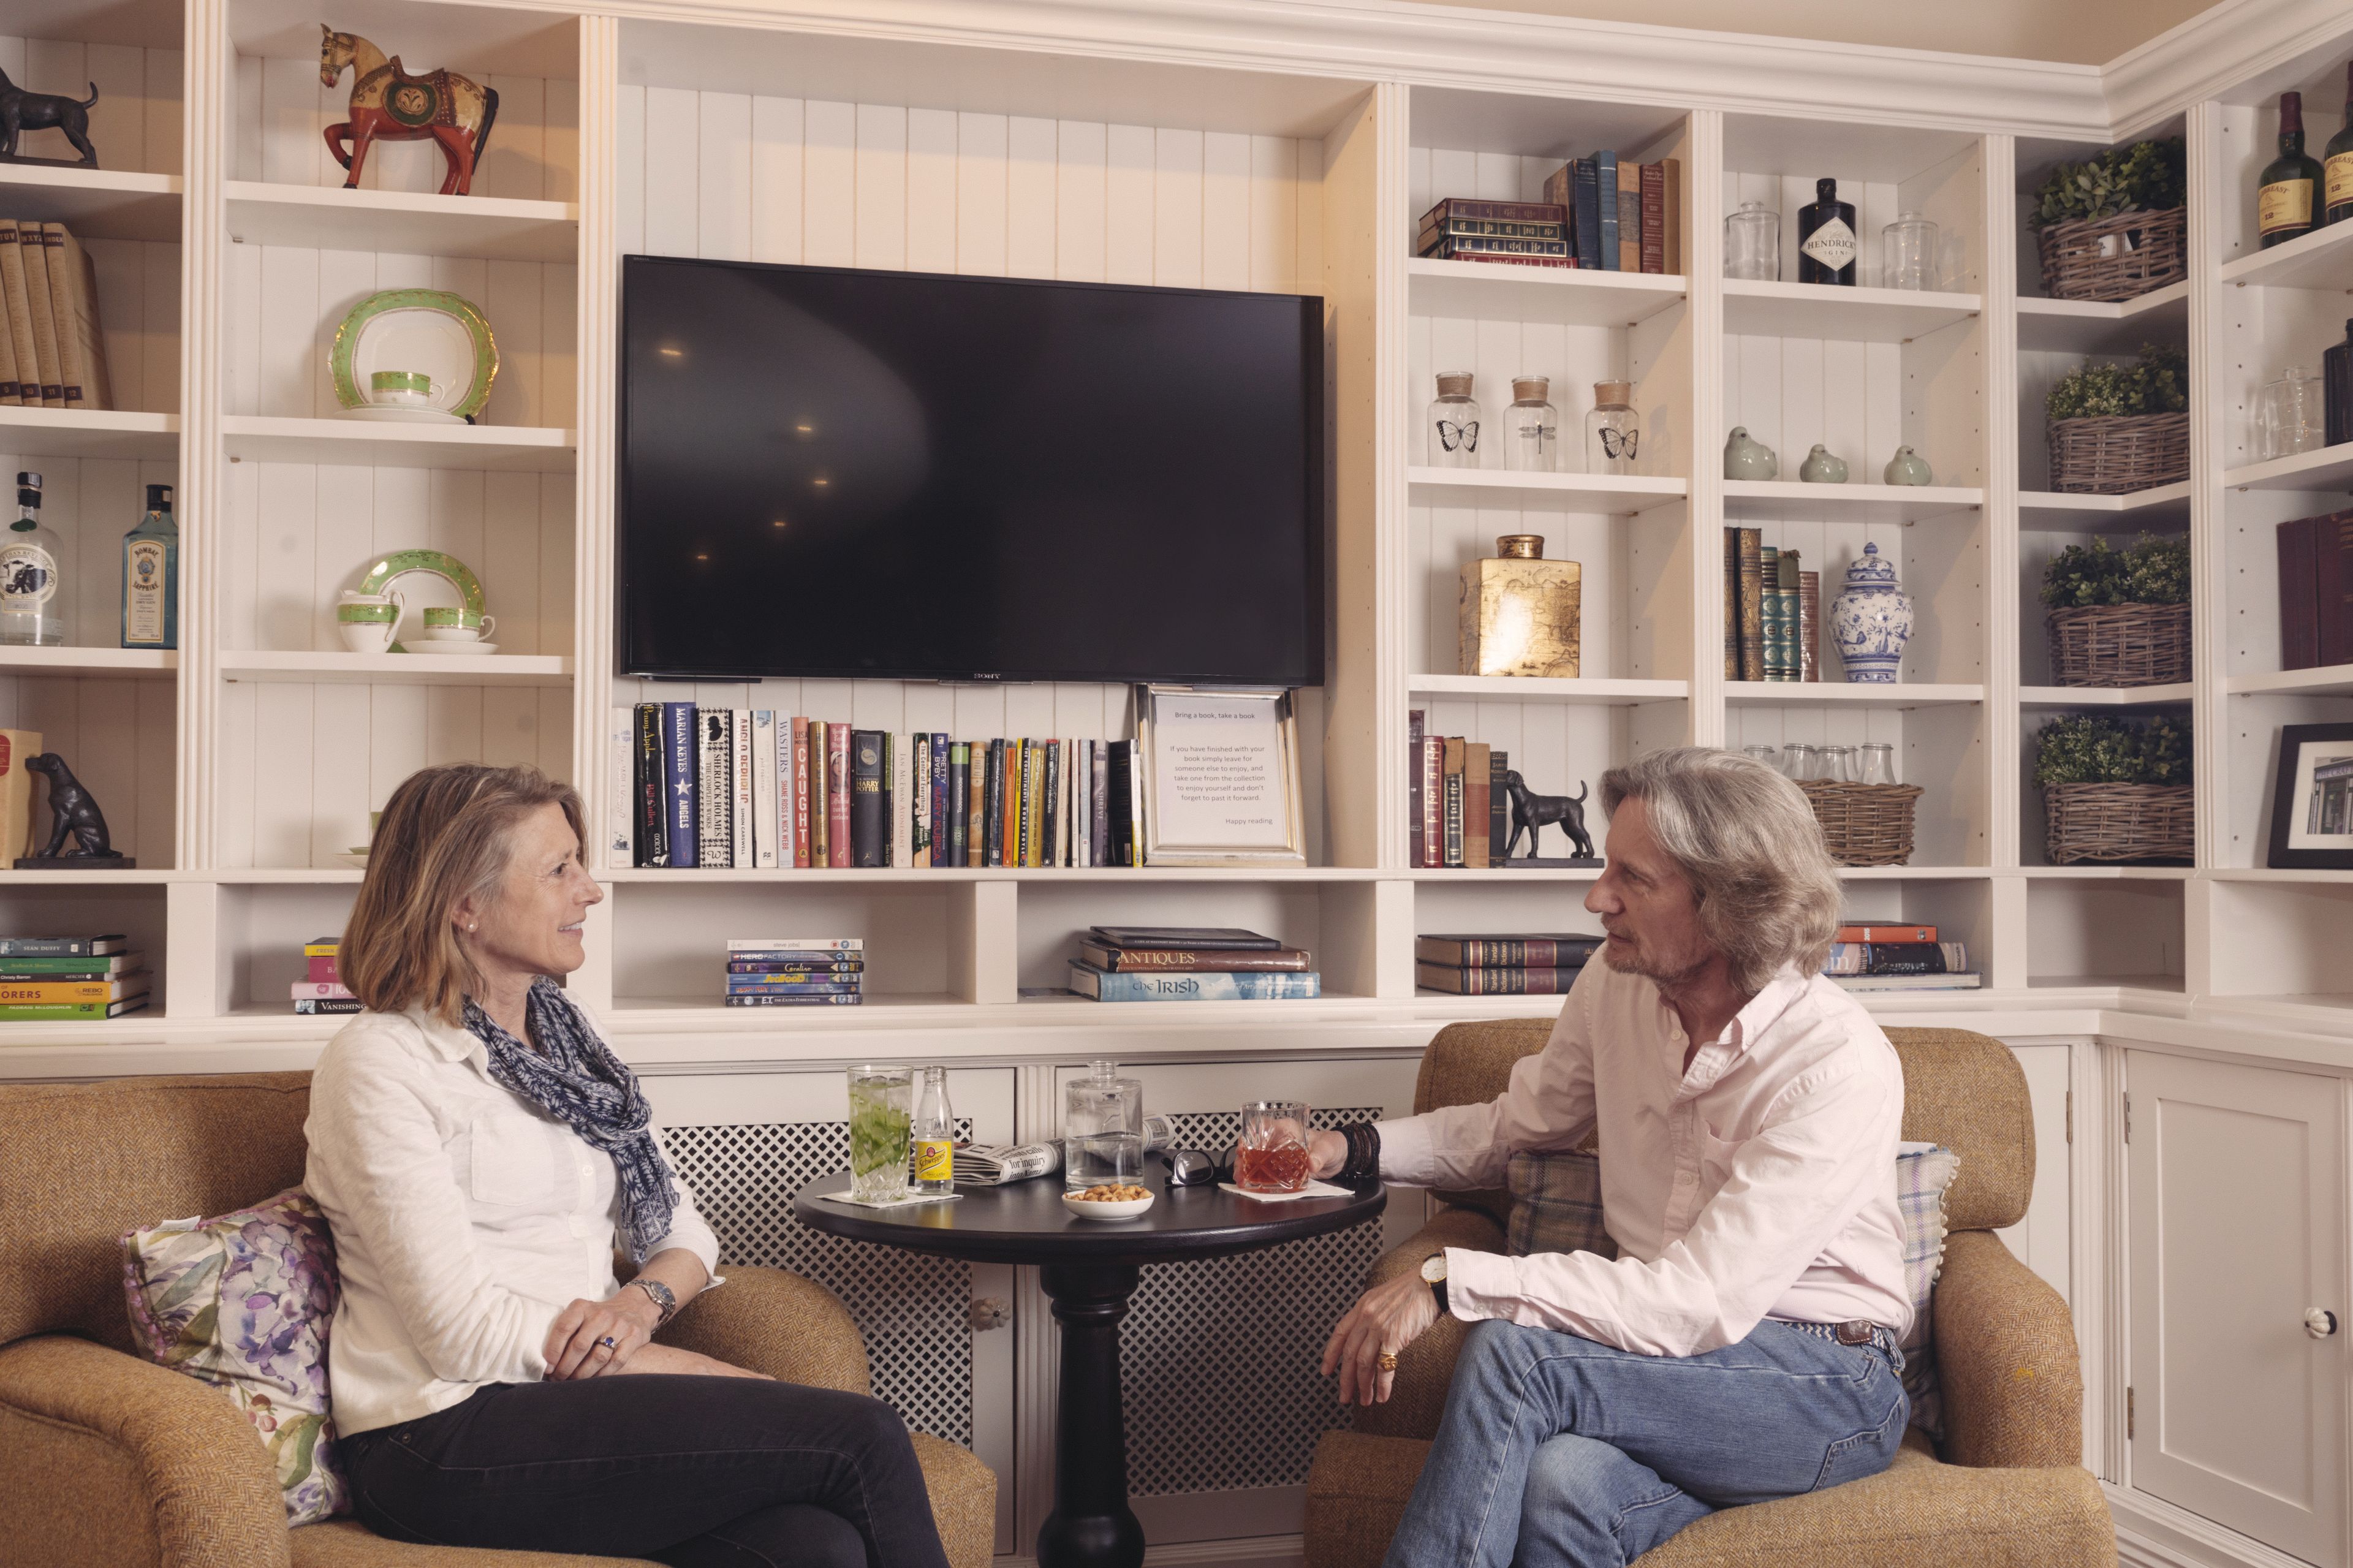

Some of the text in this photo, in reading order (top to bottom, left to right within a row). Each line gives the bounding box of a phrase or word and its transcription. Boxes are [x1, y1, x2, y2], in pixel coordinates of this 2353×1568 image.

[2331, 184, 2341, 192] 12
[2265, 212, 2274, 221] 12
[134, 547, 159, 558] BOMBAY
[132, 581, 159, 591] SAPPHIRE
[643, 706, 654, 729] Penny
[676, 708, 687, 773] MARIAN KEYES
[779, 721, 788, 773] WASTERS
[737, 717, 749, 804] ANGLO REPUBLIC
[713, 754, 722, 837] SHERLOCK HOLMES
[798, 748, 807, 843] CAUGHT
[645, 784, 656, 827] Bill Cullen
[679, 799, 689, 828] ANGELS
[1116, 952, 1195, 965] ANTIQUES
[785, 963, 812, 972] Coraline
[1133, 981, 1154, 991] the
[321, 1002, 366, 1010] VANISHING
[919, 1151, 945, 1170] Schweppes
[1002, 1149, 1027, 1161] resists
[1009, 1156, 1045, 1169] for inquiry
[1009, 1171, 1023, 1180] into
